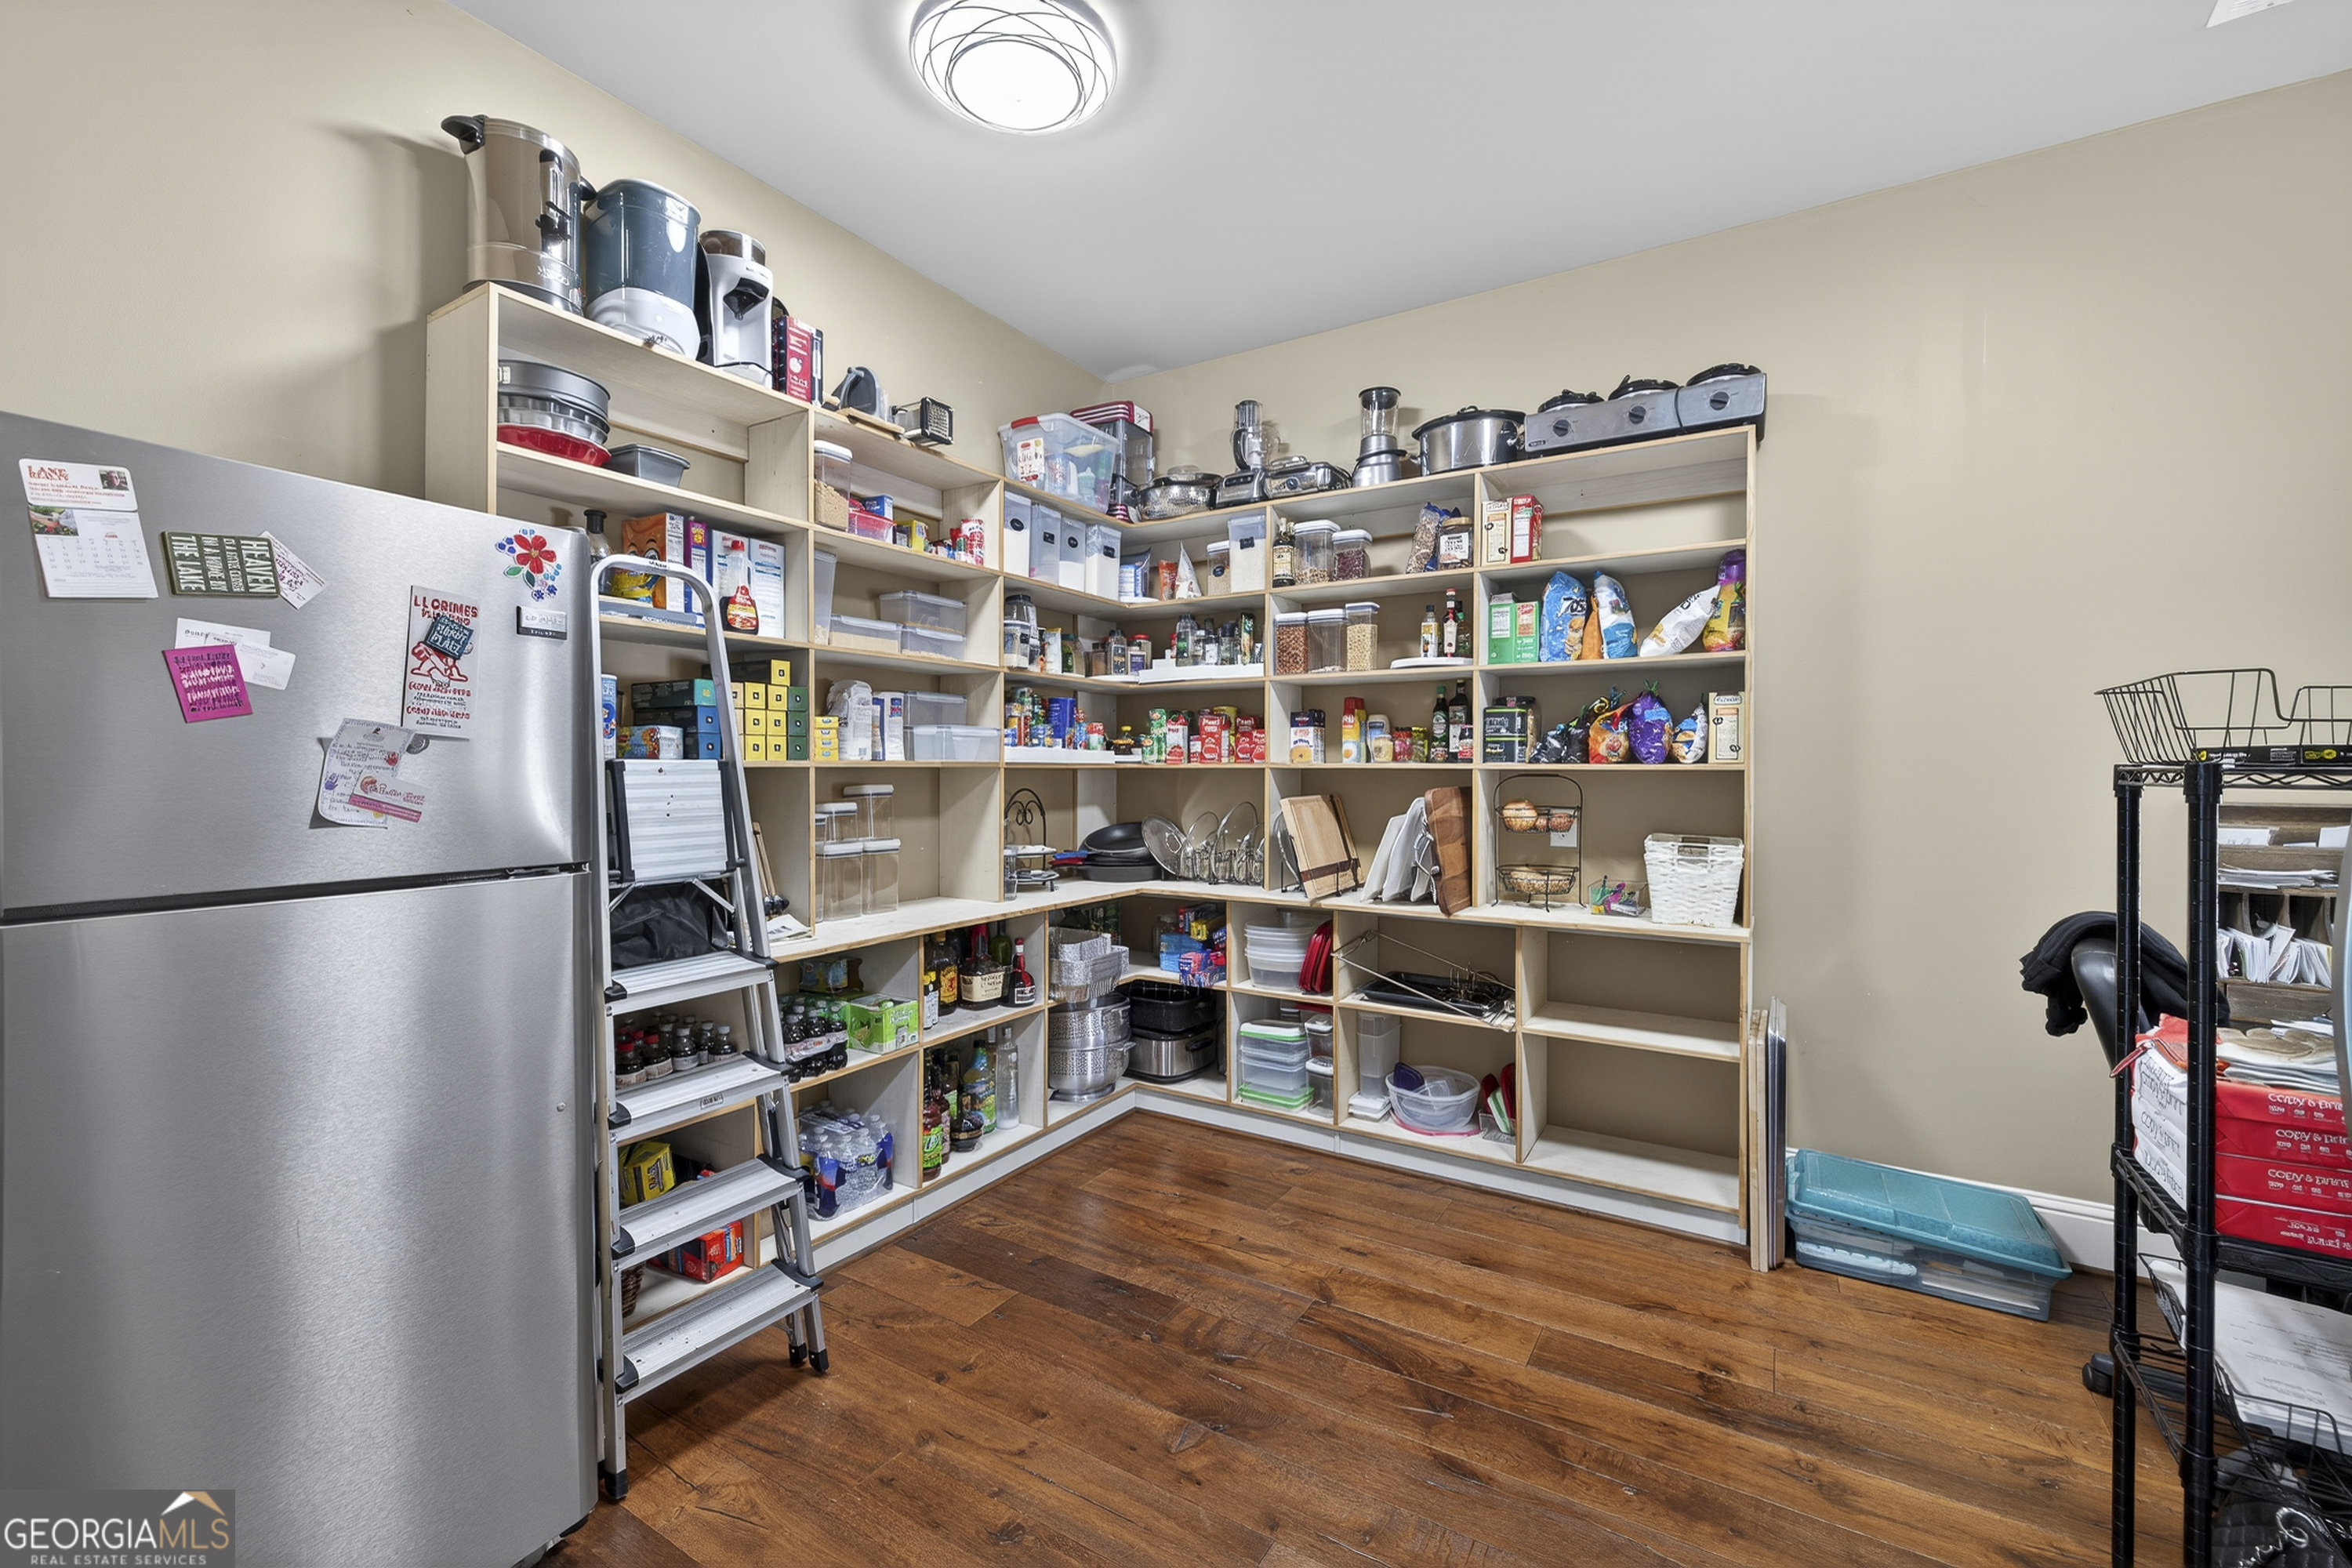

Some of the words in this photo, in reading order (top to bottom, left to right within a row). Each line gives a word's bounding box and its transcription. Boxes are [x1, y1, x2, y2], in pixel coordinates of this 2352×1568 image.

[171, 535, 200, 557] THE
[176, 560, 206, 591] LAKE
[240, 539, 276, 593] HEAVEN
